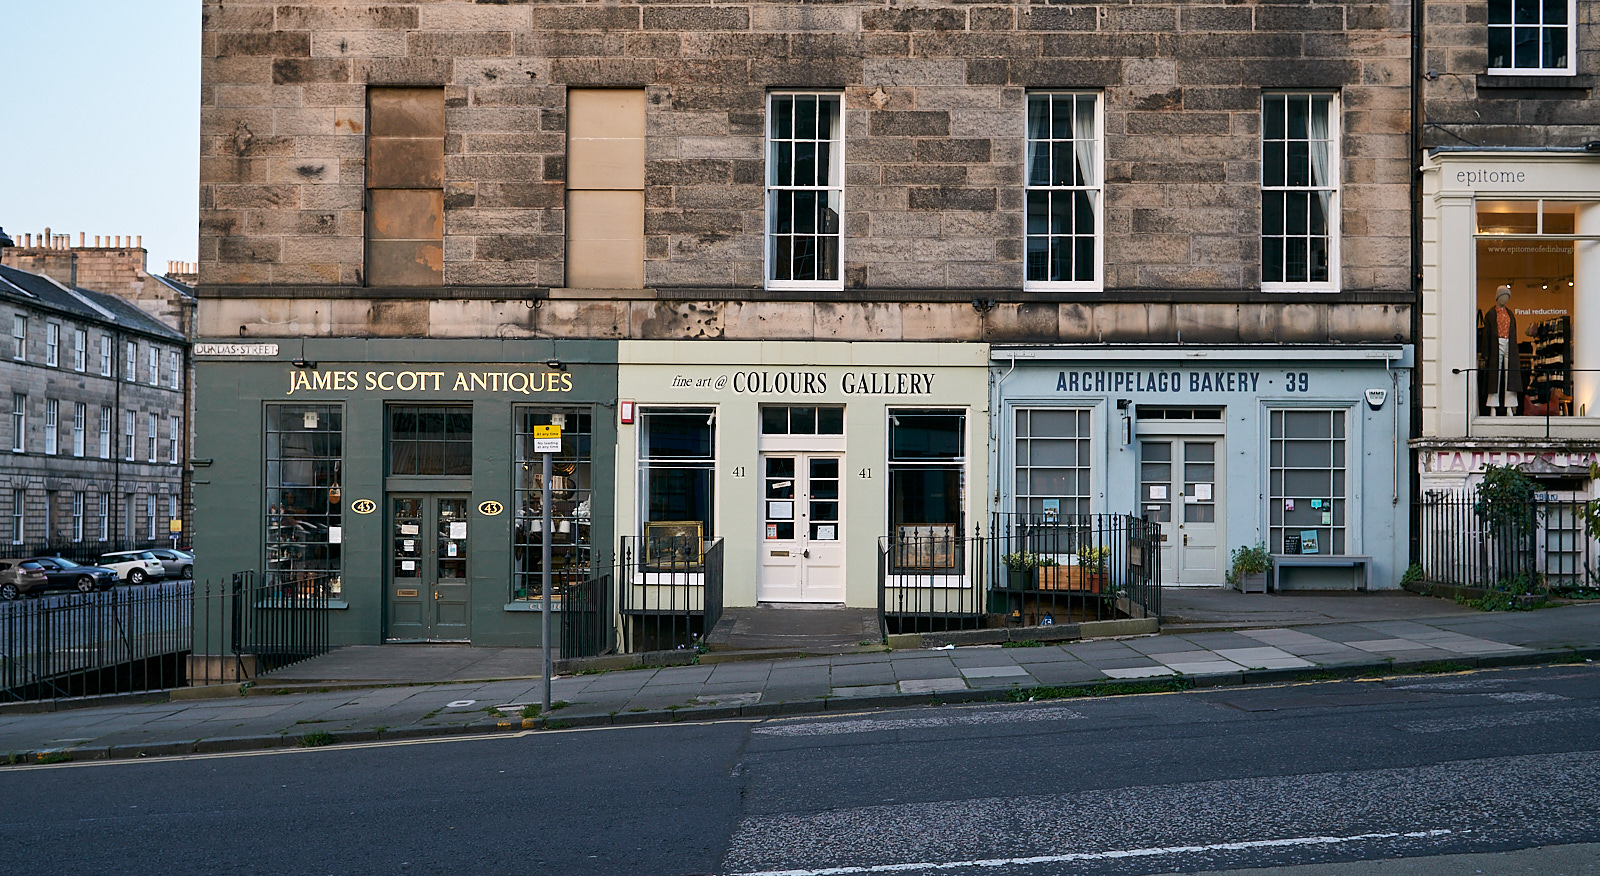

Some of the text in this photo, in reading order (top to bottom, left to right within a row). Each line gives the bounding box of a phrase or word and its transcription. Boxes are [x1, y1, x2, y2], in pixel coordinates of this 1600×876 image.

[1456, 169, 1525, 186] epitome
[240, 345, 276, 355] STREET
[286, 370, 573, 395] JAMES SCOTT ANTIQUES
[671, 371, 936, 395] fine art @ COLOURS GALLERY
[1056, 371, 1309, 393] ARCHIPELAGO BAKERY 39
[732, 466, 746, 478] 41
[858, 467, 872, 479] 41
[357, 501, 371, 513] 43
[484, 503, 498, 514] 43
